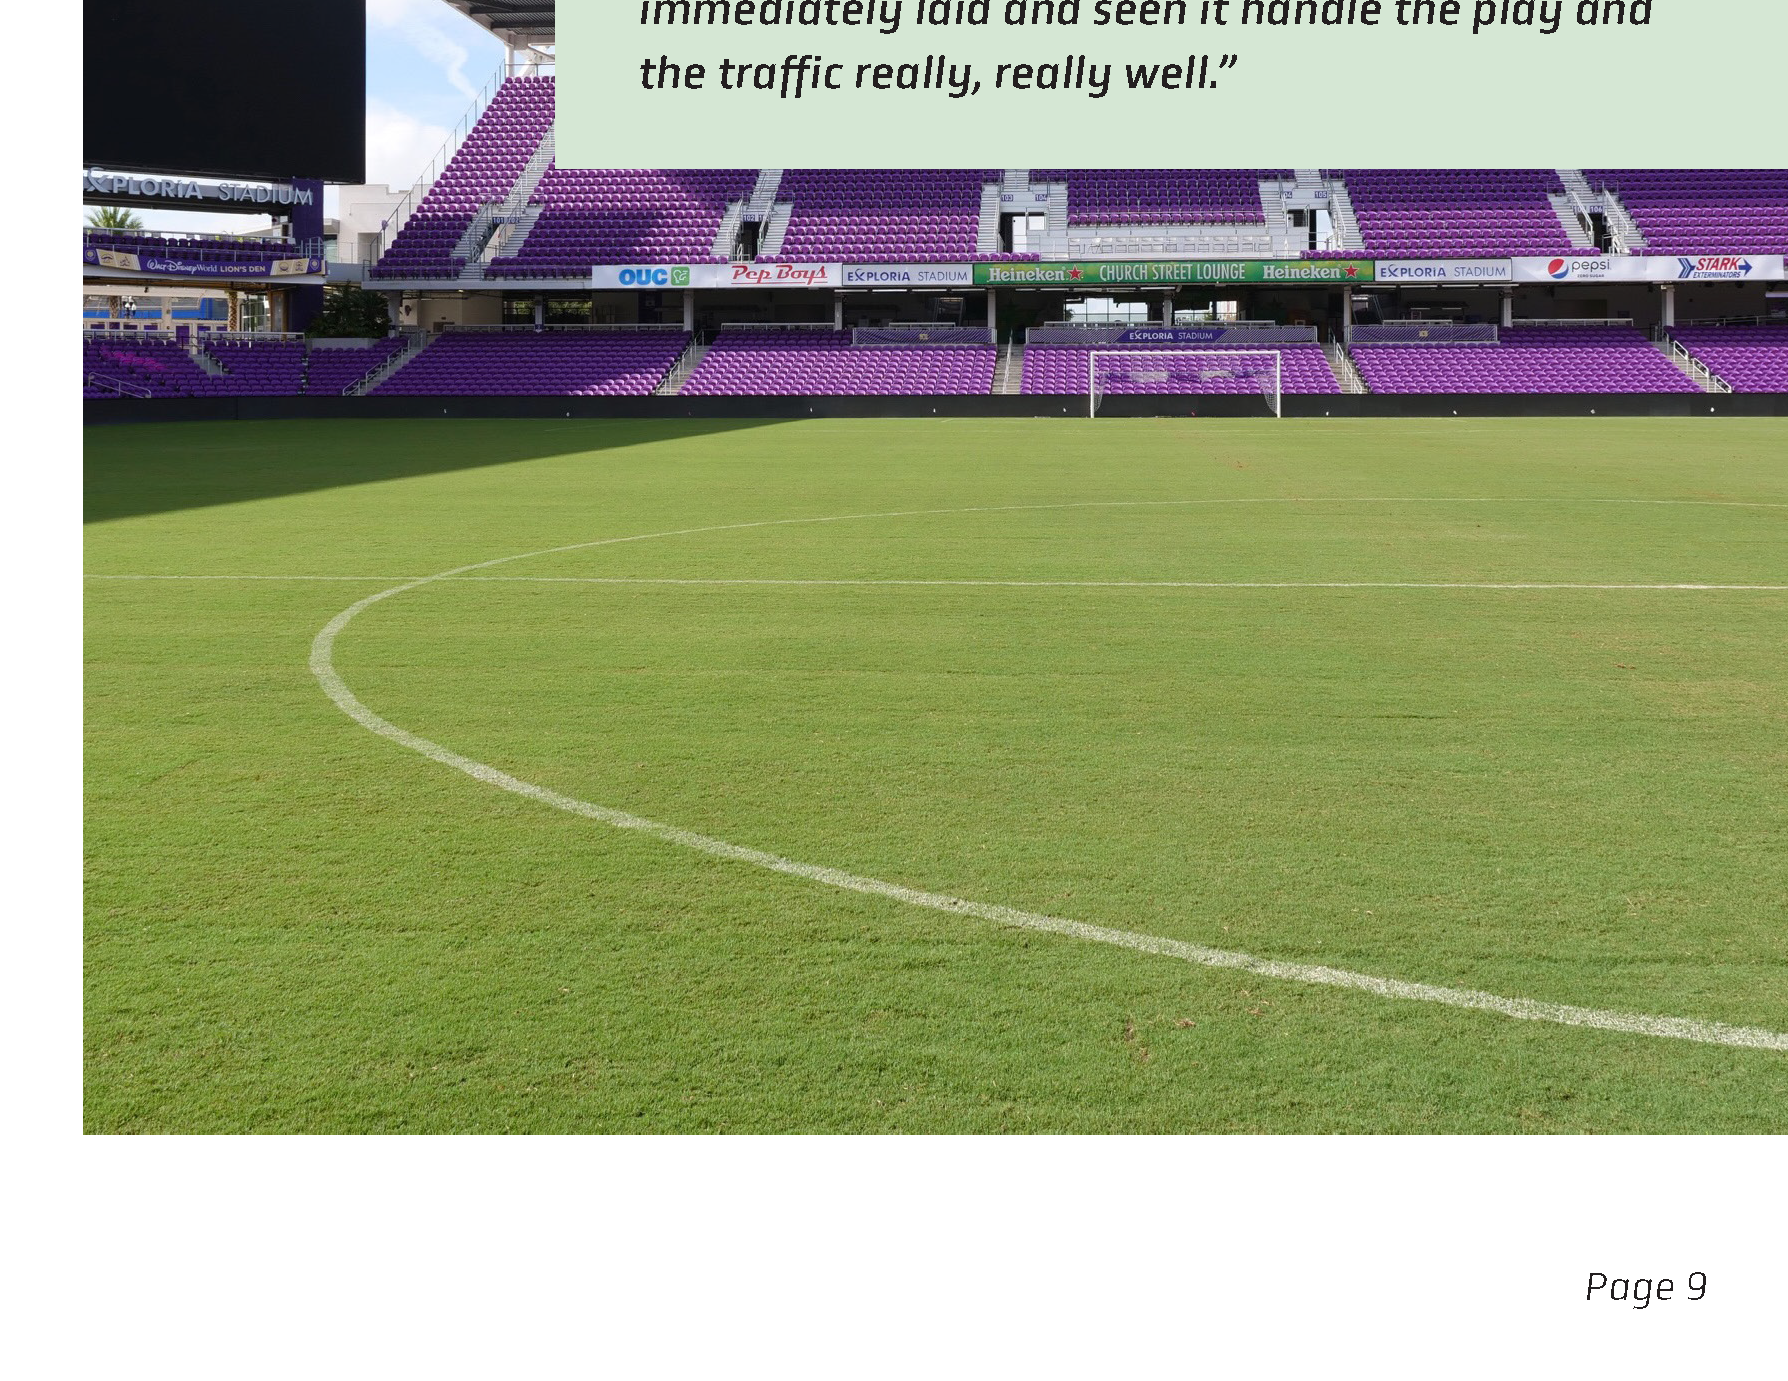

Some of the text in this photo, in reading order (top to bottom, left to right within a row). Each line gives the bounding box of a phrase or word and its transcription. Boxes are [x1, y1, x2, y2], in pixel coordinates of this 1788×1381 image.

[218, 183, 313, 206] STADIUM
[220, 265, 247, 273] LION'S
[249, 265, 266, 273] DEN
[1380, 264, 1506, 278] EXPLORIA STADIUM
[1571, 258, 1610, 273] pepsi
[1696, 257, 1742, 271] STARK
[619, 268, 668, 286] OUC
[731, 264, 828, 285] Pep Boys
[848, 269, 968, 282] EXPLORIA STADIUM
[987, 267, 1065, 282] Heineken
[1099, 263, 1246, 282] CHURCH STREET LOUNGE
[1262, 265, 1341, 280] Heineken
[1693, 271, 1741, 279] EXTERMINATORS
[1129, 330, 1213, 340] EXPLORIA STADIUM
